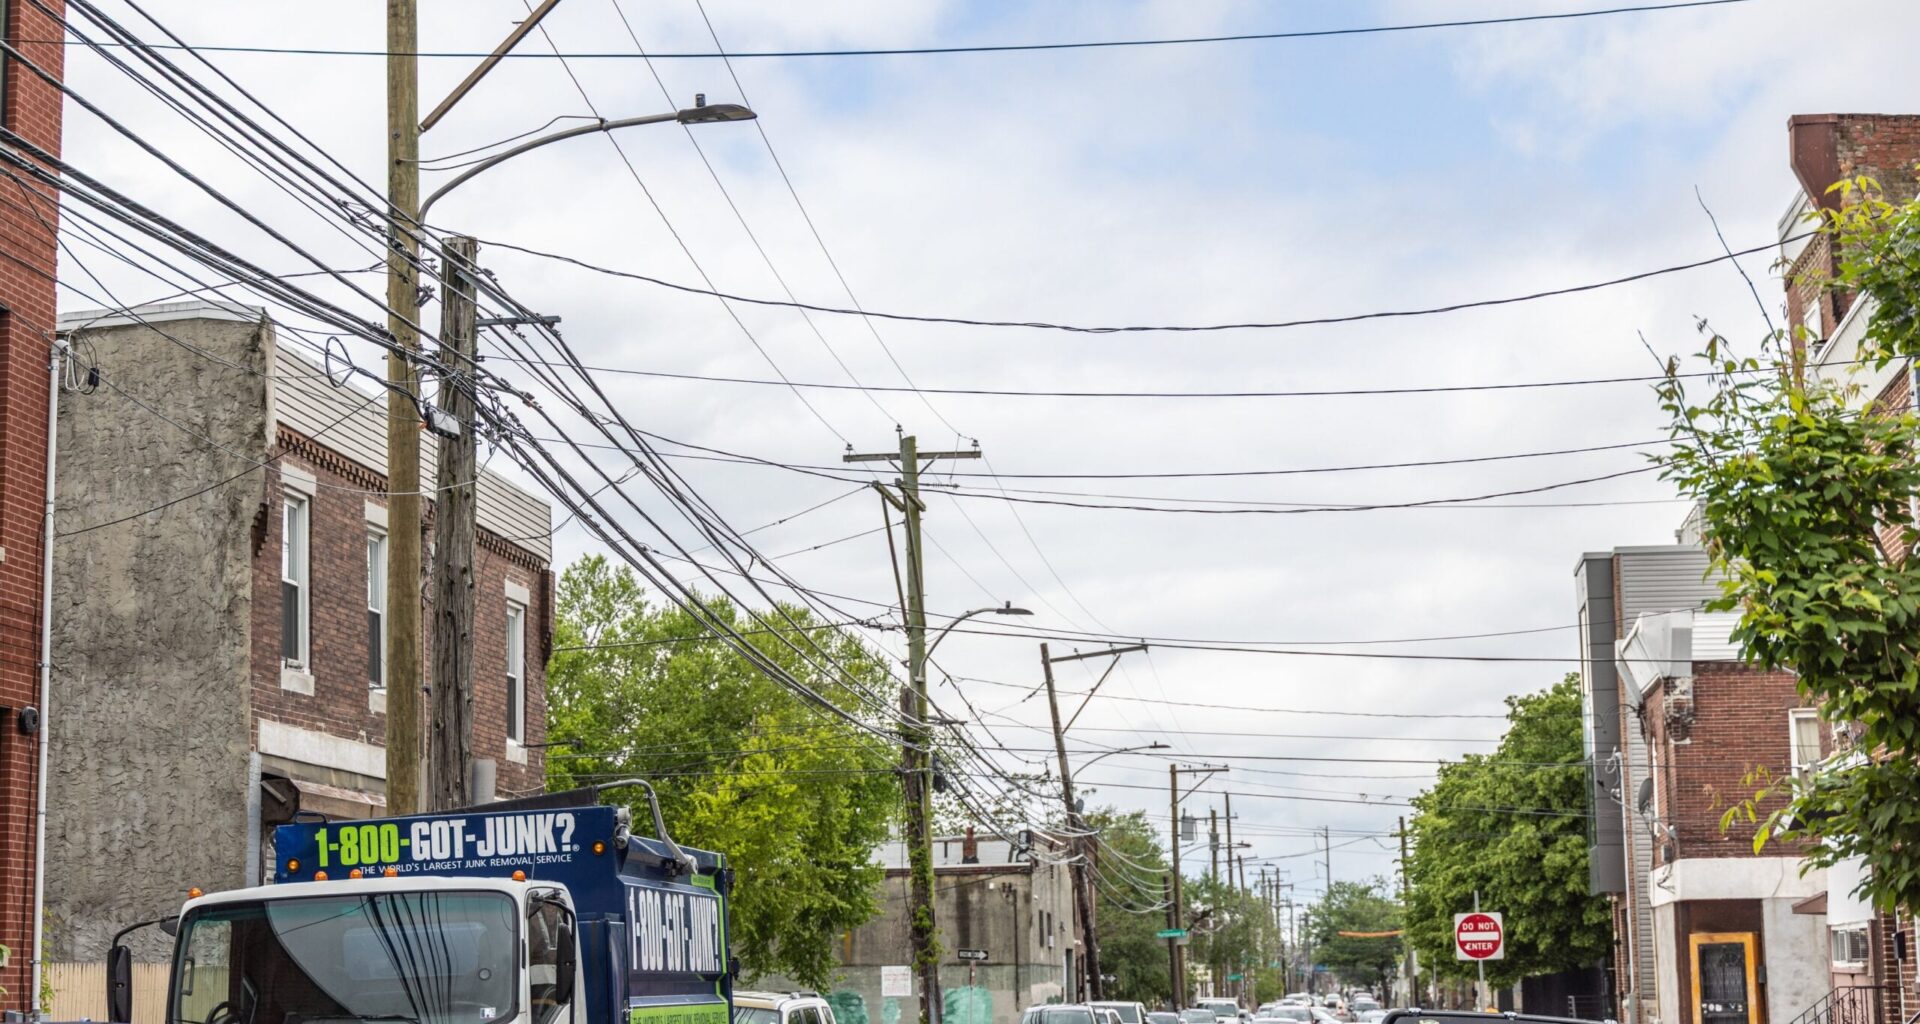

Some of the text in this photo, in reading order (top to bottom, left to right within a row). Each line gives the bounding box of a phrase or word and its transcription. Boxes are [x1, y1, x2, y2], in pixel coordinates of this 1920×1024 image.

[314, 812, 575, 867] 1-800-GOT-JUNK?
[360, 866, 375, 874] THE
[423, 861, 462, 871] LARGEST
[465, 859, 487, 868] JUNK
[490, 857, 533, 867] REMOVAL
[536, 854, 572, 864] SERVICE
[629, 887, 719, 972] 1-800-GOT-JUNK?
[1462, 922, 1494, 931] DO NOT
[1465, 942, 1493, 950] ENTER
